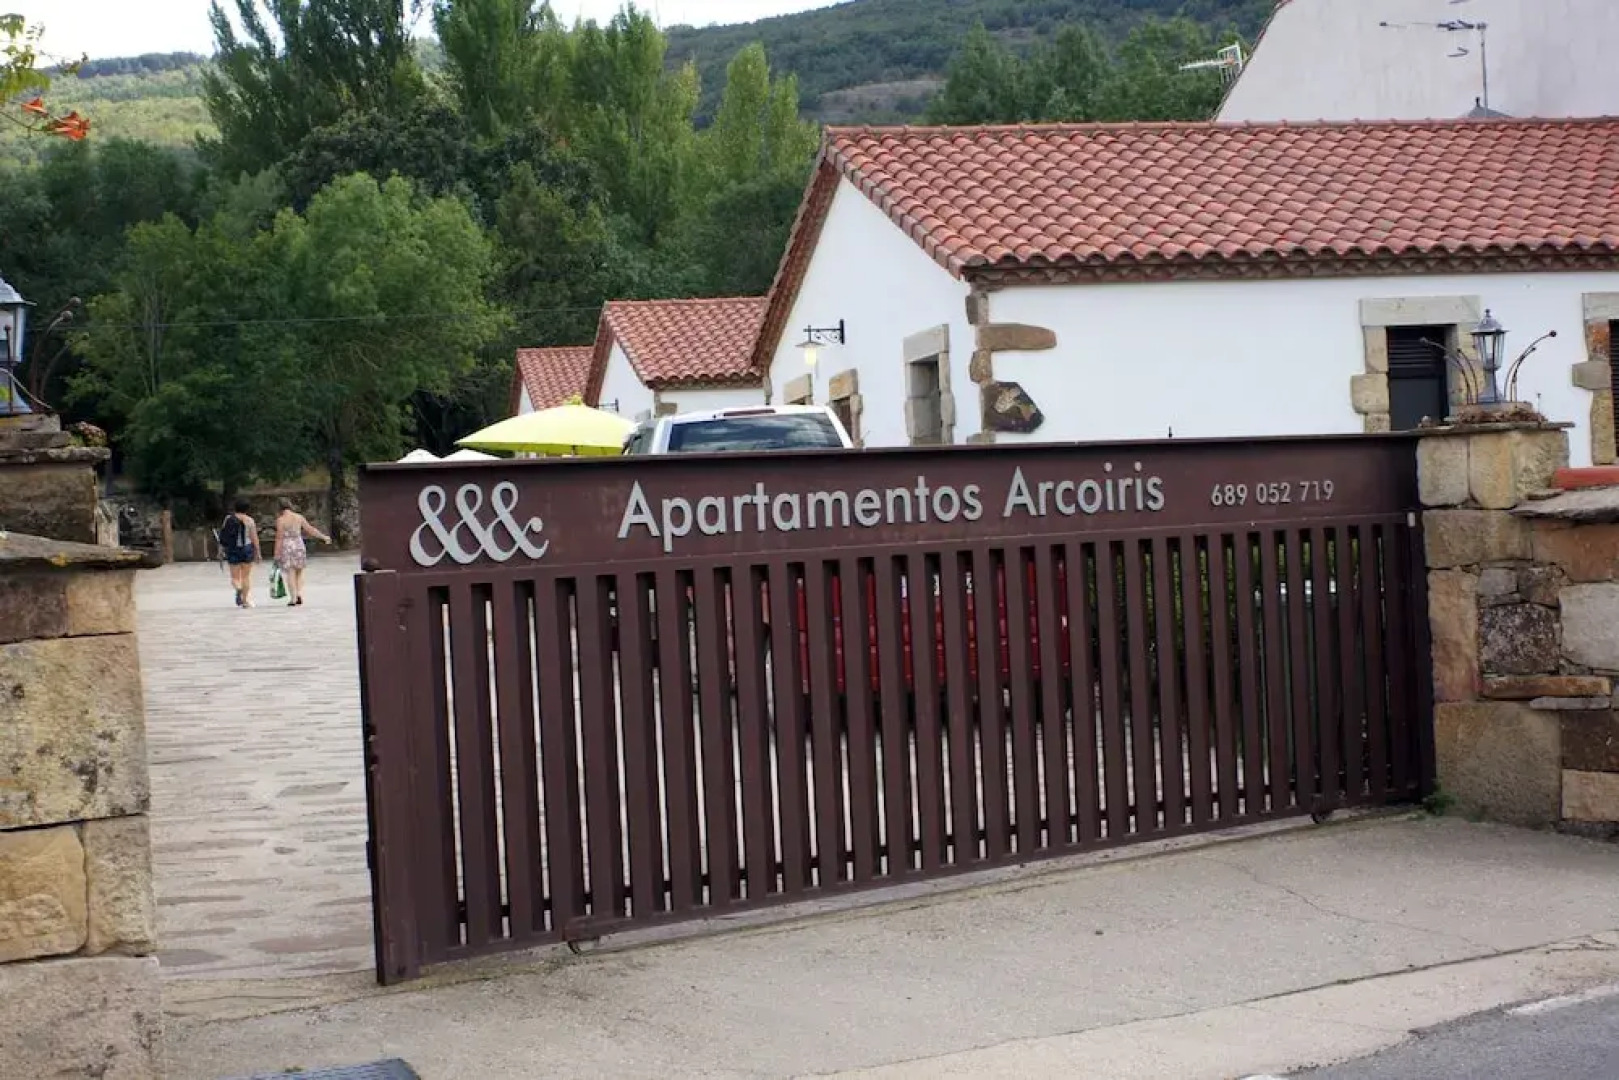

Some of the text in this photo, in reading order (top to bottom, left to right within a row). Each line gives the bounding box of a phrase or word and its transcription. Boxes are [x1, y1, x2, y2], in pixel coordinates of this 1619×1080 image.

[617, 475, 983, 552] Apartamentos
[1003, 462, 1165, 517] Arcoiris
[1211, 484, 1247, 506] 689
[1256, 482, 1291, 504] 052
[1299, 480, 1334, 501] 719
